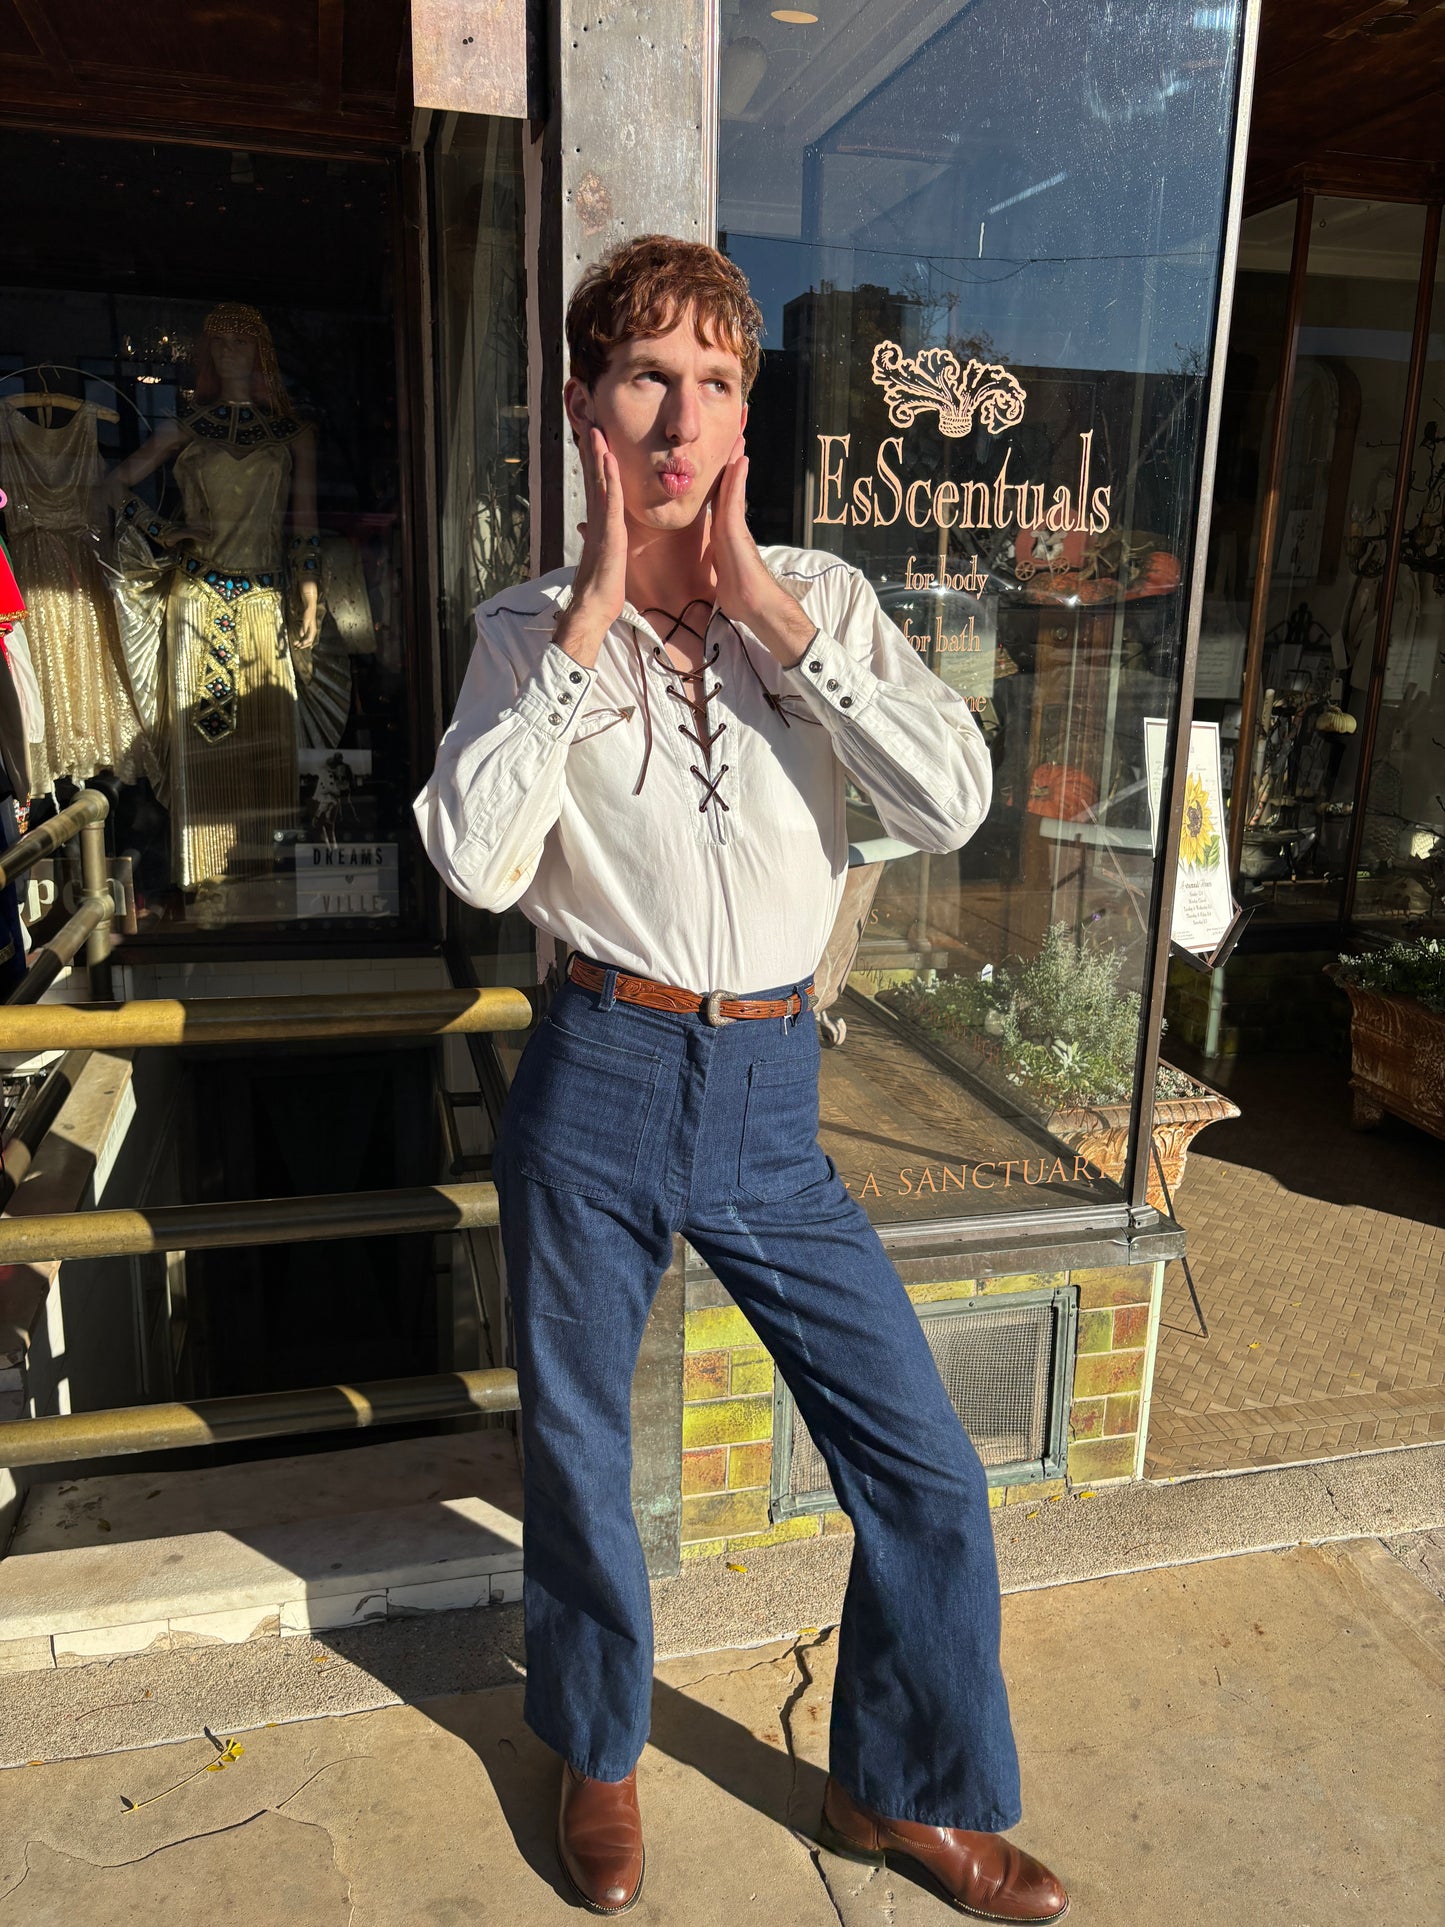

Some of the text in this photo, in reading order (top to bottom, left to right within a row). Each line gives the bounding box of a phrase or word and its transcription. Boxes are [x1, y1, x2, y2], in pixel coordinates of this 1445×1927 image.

[812, 428, 1111, 536] EsScentuals
[904, 554, 989, 600] for body
[903, 616, 982, 653] for bath
[313, 847, 384, 866] DREAMS
[858, 1172, 882, 1199] A
